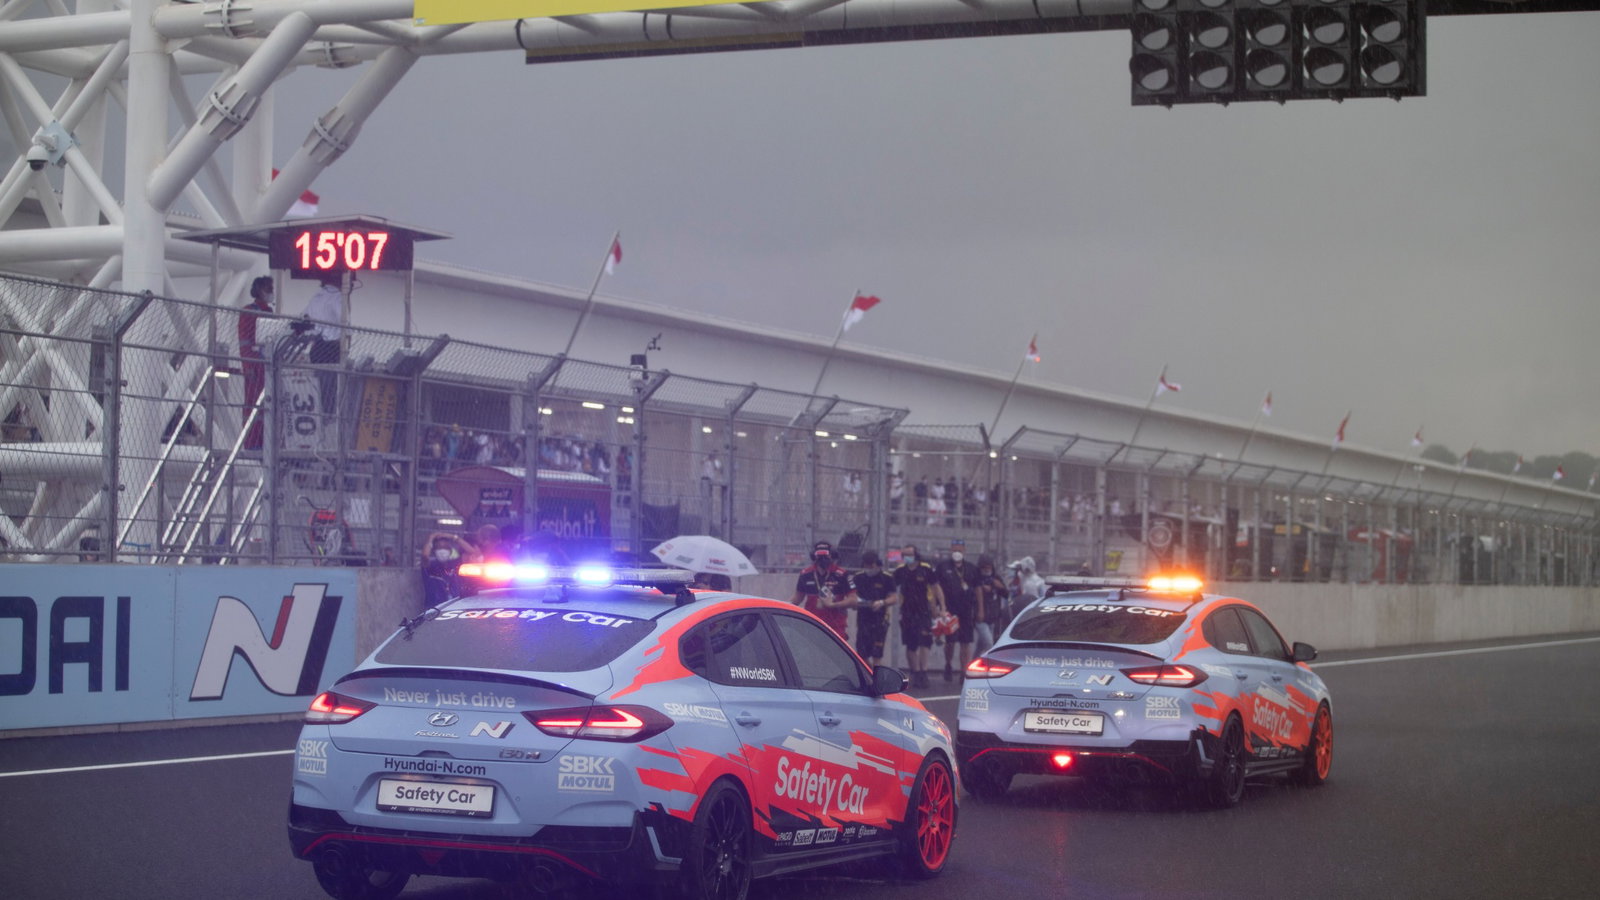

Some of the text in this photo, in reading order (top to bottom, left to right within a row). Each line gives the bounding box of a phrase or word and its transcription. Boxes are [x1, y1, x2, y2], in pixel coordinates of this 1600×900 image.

[295, 232, 388, 269] 15'07
[293, 393, 316, 436] 30
[435, 609, 632, 628] Safety Car
[1040, 604, 1173, 617] Safety Car
[188, 582, 343, 702] N
[1025, 656, 1114, 668] Never just drive
[730, 667, 777, 680] #NWorldSBK
[384, 687, 516, 708] Never just drive
[1030, 699, 1100, 709] Hyundai-N.com
[1036, 716, 1092, 728] Safety Car
[1146, 709, 1180, 718] MOTUL
[1253, 698, 1280, 738] Safety
[469, 721, 516, 739] N
[299, 759, 326, 772] MOTUL
[384, 757, 486, 775] Hyundai-N.com
[560, 775, 613, 789] MOTUL
[775, 756, 870, 816] Safety Car
[395, 786, 476, 804] Safety Car
